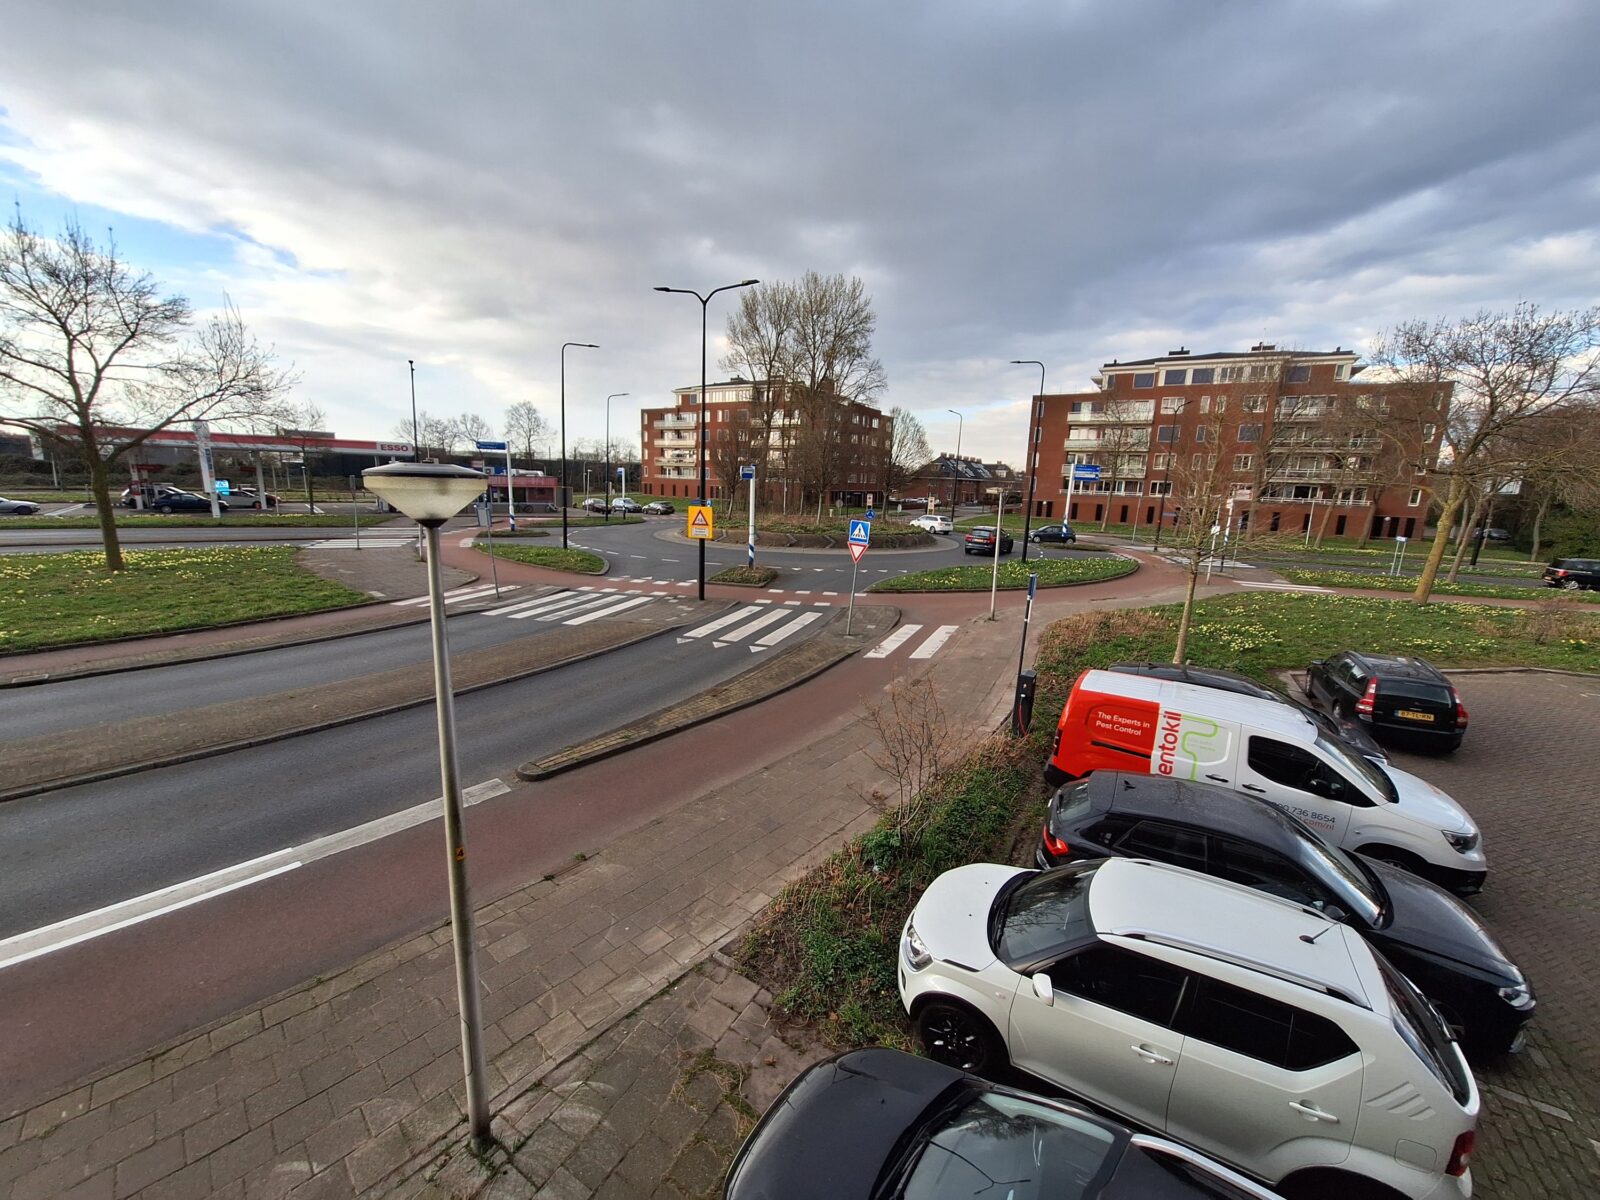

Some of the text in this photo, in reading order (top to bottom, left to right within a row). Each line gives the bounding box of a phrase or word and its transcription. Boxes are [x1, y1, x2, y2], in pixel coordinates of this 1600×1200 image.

[380, 443, 409, 452] ESSO
[1098, 711, 1112, 721] The
[1113, 714, 1142, 727] Experts
[1096, 720, 1142, 736] Pest Control
[1158, 710, 1182, 776] entokil
[1291, 806, 1309, 817] 736
[1311, 811, 1336, 824] 8654
